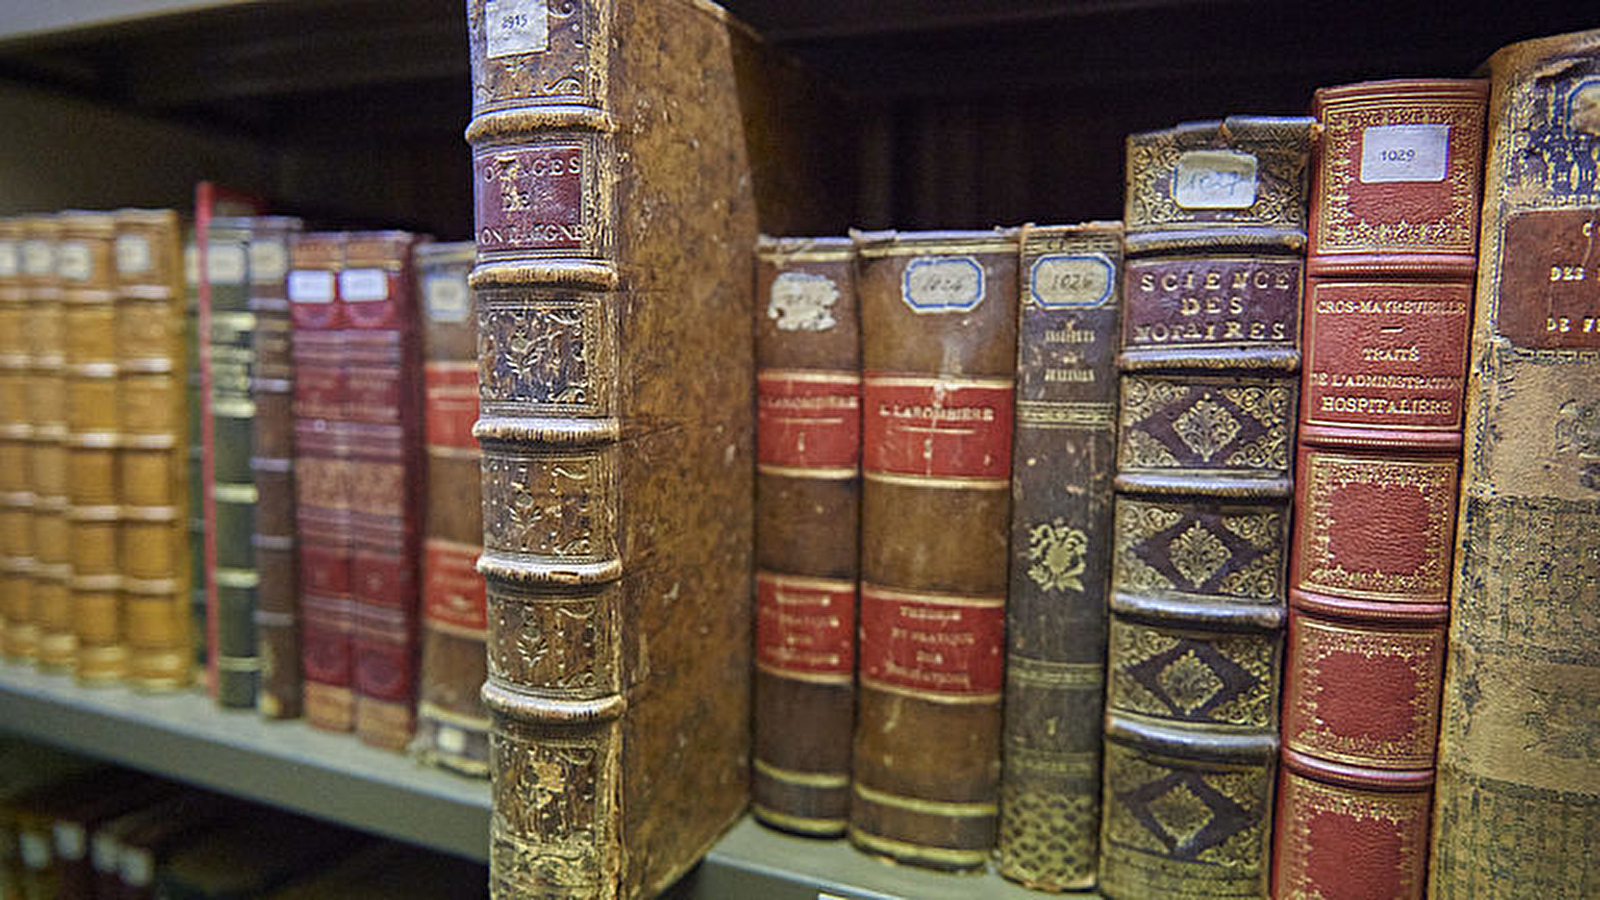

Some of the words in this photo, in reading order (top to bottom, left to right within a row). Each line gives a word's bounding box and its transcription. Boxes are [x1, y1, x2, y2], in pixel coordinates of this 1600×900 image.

[1381, 149, 1416, 162] 1029
[1140, 269, 1291, 293] SCIENCE
[1549, 265, 1586, 282] DES
[1180, 296, 1244, 316] DES
[1133, 321, 1286, 342] NOTAIRES
[1363, 345, 1420, 362] TRAITÉ
